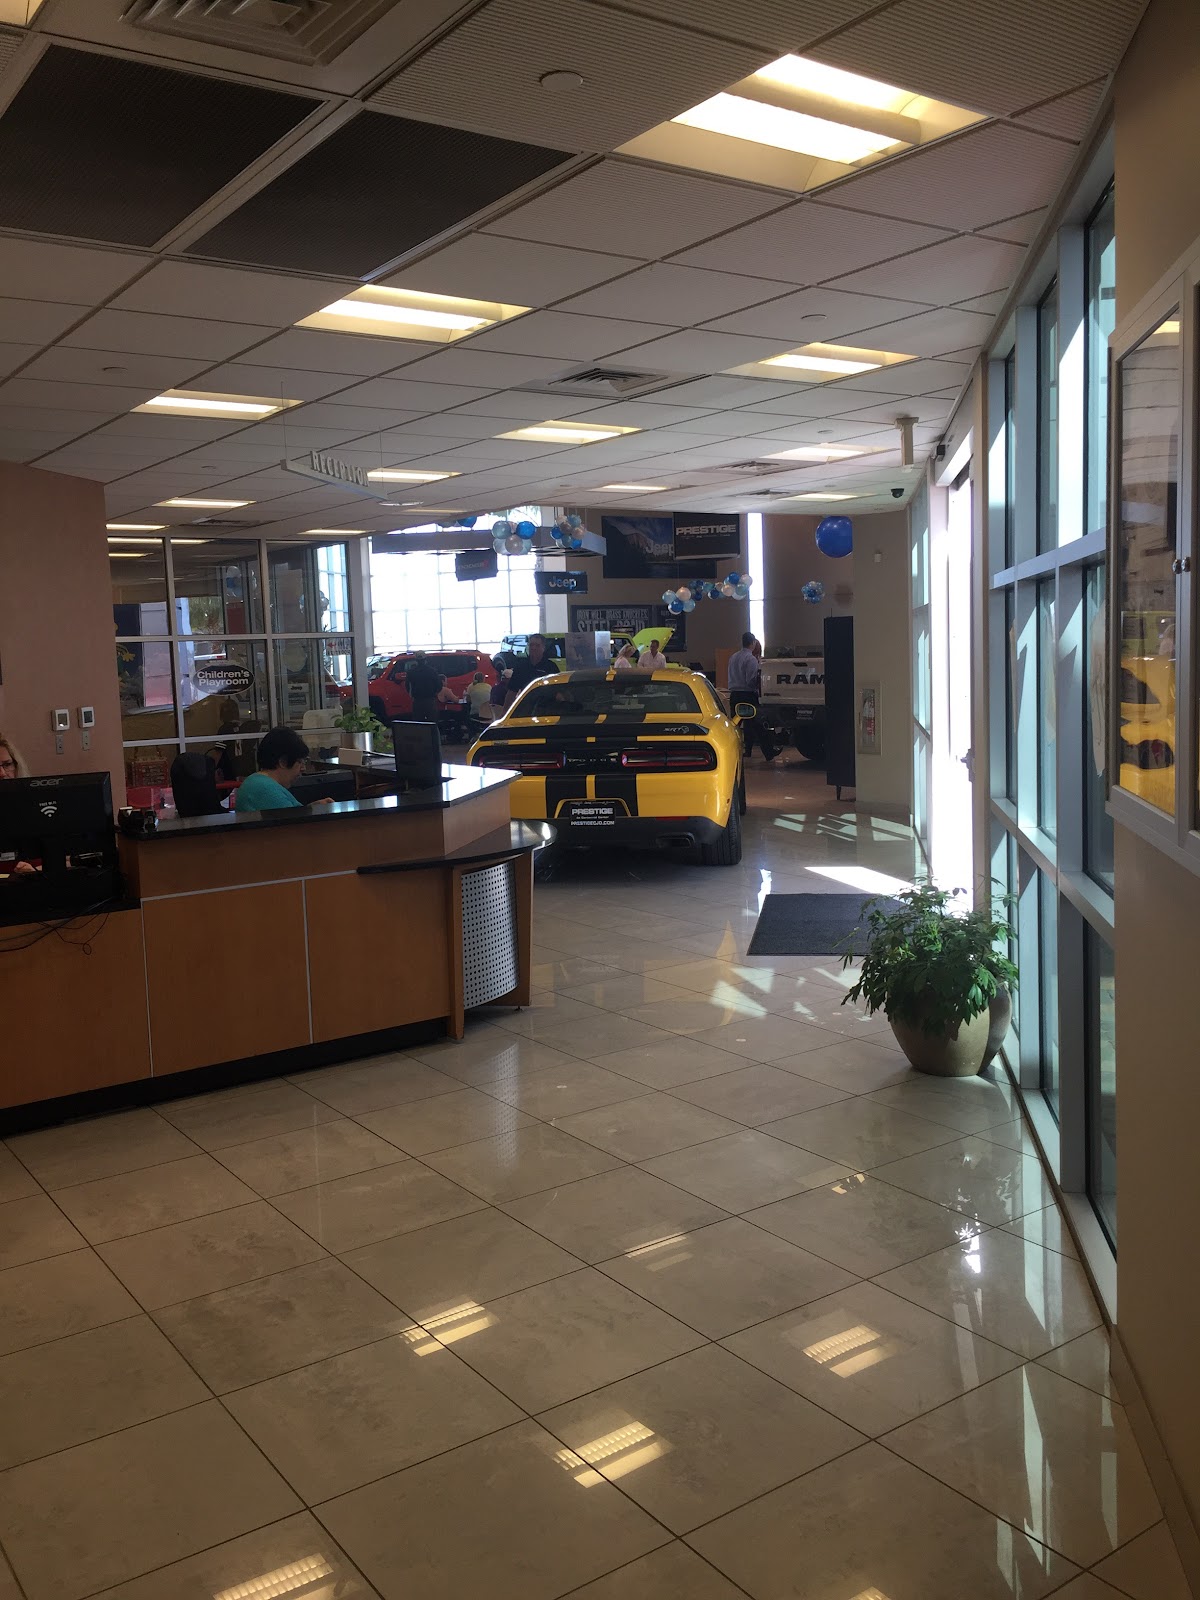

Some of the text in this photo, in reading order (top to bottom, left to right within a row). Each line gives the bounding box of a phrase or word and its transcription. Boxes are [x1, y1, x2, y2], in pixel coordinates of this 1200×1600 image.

[311, 451, 369, 487] RECEPTION
[676, 524, 737, 536] PRESTIGE
[549, 576, 577, 590] Jeep
[196, 670, 250, 679] Children's
[777, 674, 825, 685] RAM
[198, 678, 249, 687] Playroom
[30, 778, 64, 787] acer
